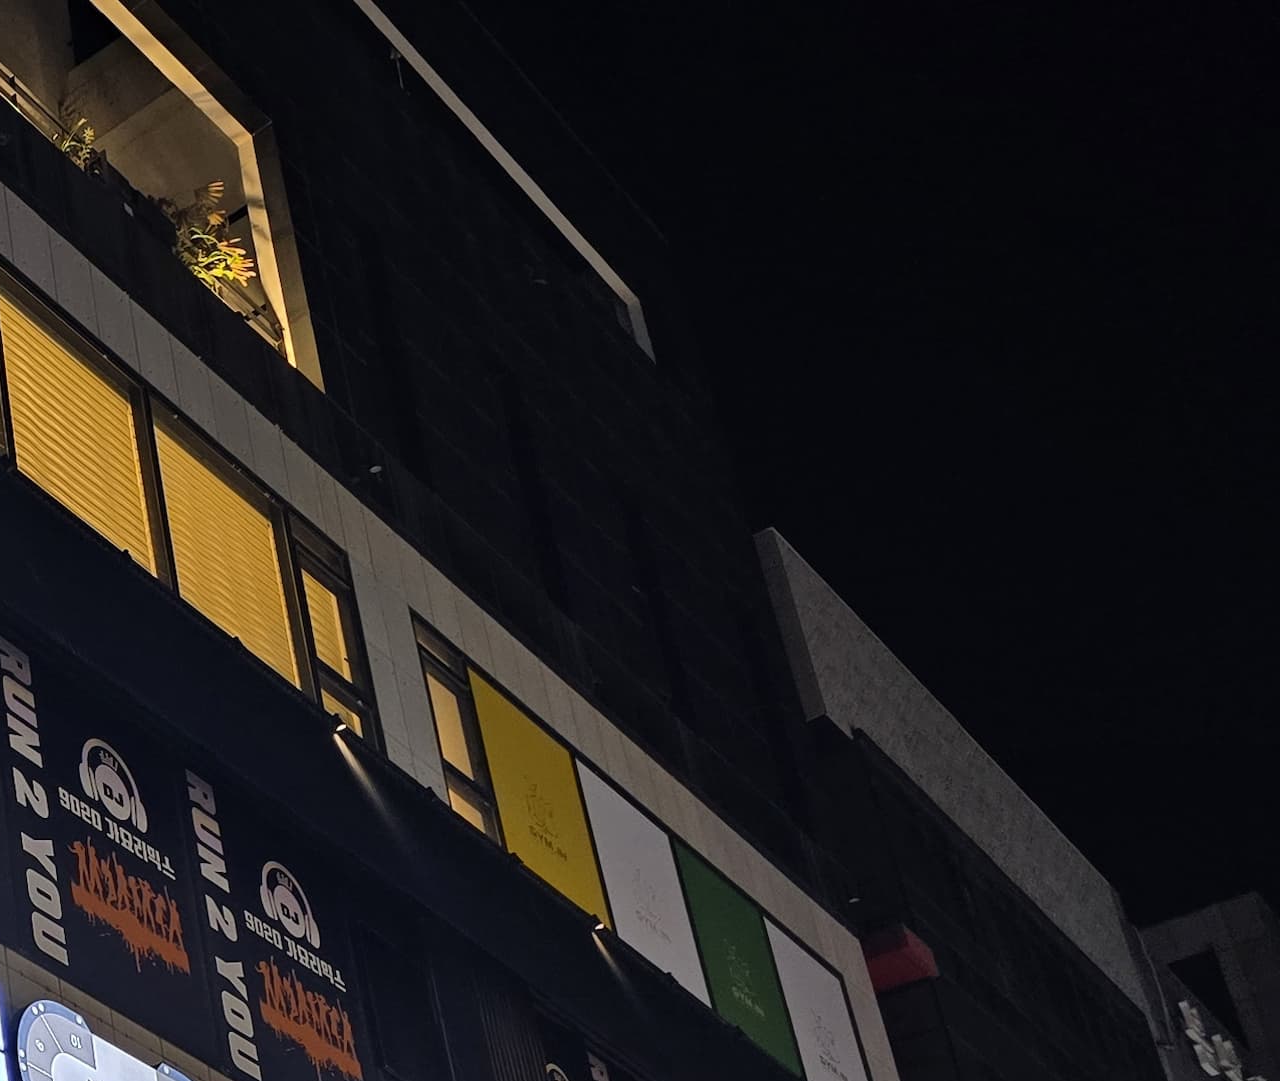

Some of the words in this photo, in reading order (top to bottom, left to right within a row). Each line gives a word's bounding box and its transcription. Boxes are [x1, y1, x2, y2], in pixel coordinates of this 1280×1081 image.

[12, 765, 50, 819] 2
[58, 785, 104, 833] 9020
[185, 768, 231, 894] RUN
[20, 831, 70, 967] YOU
[204, 893, 239, 943] 2
[243, 909, 284, 951] 9020
